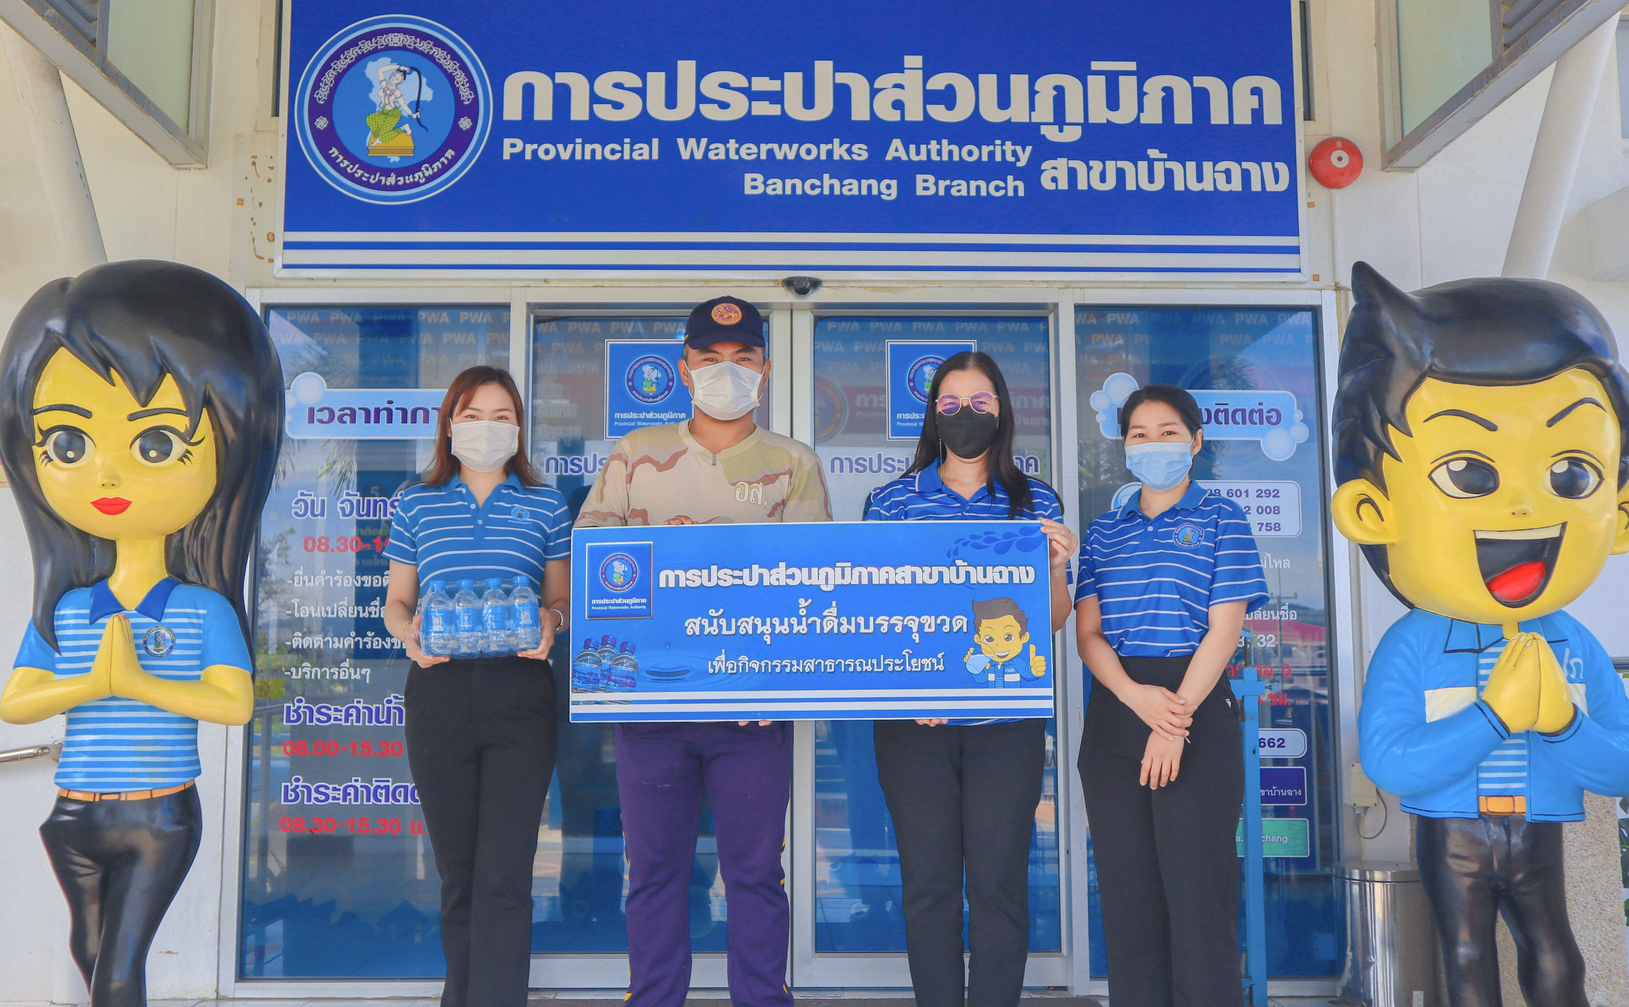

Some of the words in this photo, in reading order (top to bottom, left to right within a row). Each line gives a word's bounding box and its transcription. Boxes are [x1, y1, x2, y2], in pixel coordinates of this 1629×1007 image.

[503, 55, 1283, 142] การประปาส่วนภูมิภาค
[502, 137, 659, 161] Provincial
[677, 137, 869, 162] Waterworks
[885, 138, 1033, 167] Authority
[328, 146, 456, 186] การประปาส่วนภูมิภาค
[1040, 148, 1290, 192] สาขาบ้านฉาง
[743, 173, 898, 200] Banchang
[915, 174, 1025, 197] Branch
[418, 312, 451, 323] PWA
[460, 312, 493, 323] PWA
[1106, 313, 1140, 324] PWA
[1235, 313, 1268, 325] PWA
[568, 322, 601, 333] PWA
[610, 322, 643, 333] PWA
[653, 322, 685, 333] PWA
[828, 321, 860, 332] PWA
[870, 321, 903, 332] PWA
[912, 321, 945, 332] PWA
[955, 322, 988, 332] PWA
[997, 322, 1030, 332] PWA
[443, 333, 476, 344] PWA
[487, 333, 509, 344] PW
[1091, 334, 1125, 345] PWA
[1220, 334, 1253, 345] PWA
[1262, 334, 1296, 345] PWA
[552, 343, 585, 354] PWA
[982, 342, 1014, 353] PWA
[1024, 342, 1047, 353] PW
[1226, 488, 1250, 498] 601
[1255, 488, 1280, 498] 292
[291, 490, 327, 519] วัน
[1256, 505, 1281, 515] 008
[1256, 522, 1281, 532] 758
[658, 559, 1036, 592] การประปาส่วนภูมิภาคสาขาบ้านฉาง
[684, 597, 969, 645] สนับสนุนน้ำดื่มบรรจุขวด
[1256, 633, 1276, 648] 32
[708, 648, 945, 675] เพื่อกิจกรรมสาธารณประโยชน์
[283, 740, 405, 757] 08.00-15.30
[1258, 737, 1287, 749] 662
[1260, 785, 1302, 796] ขาบ้านฉาง
[281, 817, 403, 835] 08.30-15.30
